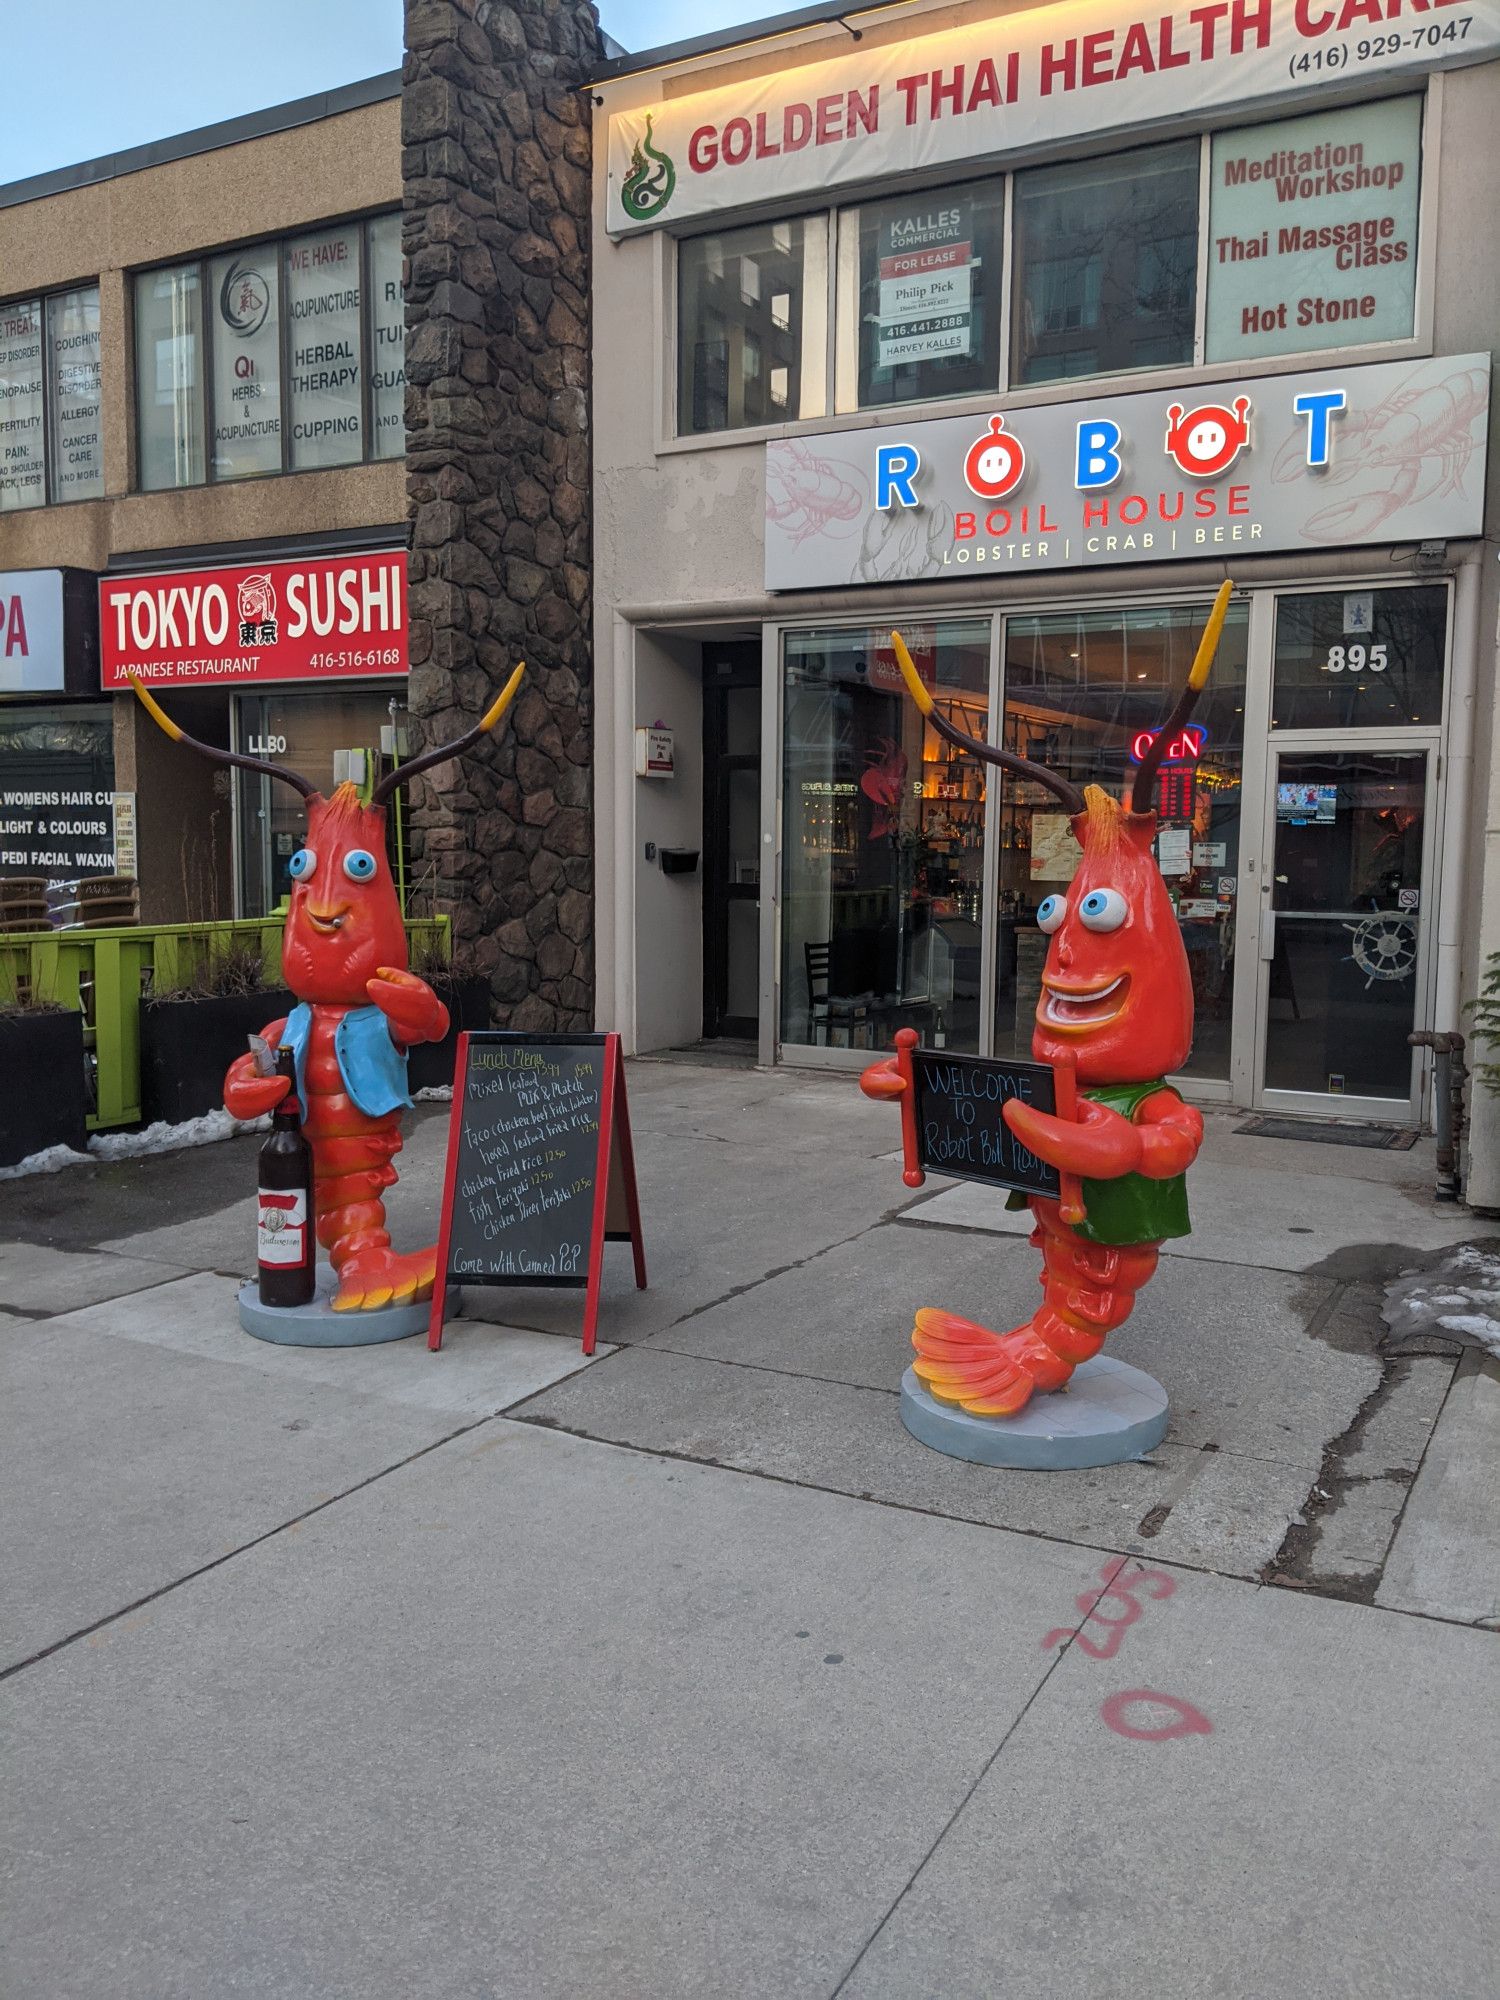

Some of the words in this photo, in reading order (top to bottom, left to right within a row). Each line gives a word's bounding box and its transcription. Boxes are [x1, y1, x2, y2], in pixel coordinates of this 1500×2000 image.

[1289, 43, 1349, 79] (416)
[1357, 17, 1473, 60] 929-7047
[688, 85, 879, 173] GOLDEN
[897, 52, 1020, 126] THAI
[1040, 0, 1272, 96] HEALTH
[1295, 0, 1471, 37] CA
[1225, 142, 1364, 187] Meditation
[1275, 161, 1404, 203] Workshop
[890, 209, 960, 237] KALLES
[890, 228, 960, 249] COMMERCIAL
[1216, 231, 1269, 263] Thai
[1278, 216, 1395, 255] Massage
[290, 250, 309, 271] WE
[312, 242, 348, 266] HAVE:
[894, 258, 918, 272] FOR
[921, 251, 956, 267] LEASE
[1335, 239, 1409, 272] Class
[895, 286, 927, 300] Philip
[930, 280, 954, 294] Pick
[290, 289, 360, 320] ACUPUNCTURE
[1242, 303, 1287, 334] Hot
[1297, 295, 1376, 326] Stone
[887, 316, 963, 337] 416.441.2888
[8, 345, 40, 362] DISORDER
[295, 341, 354, 367] HERBAL
[886, 343, 923, 355] HARVEY
[926, 336, 962, 350] KALLES
[58, 361, 102, 380] DIGESTIVE
[291, 366, 358, 394] THERAPY
[371, 369, 407, 390] GUA
[58, 378, 103, 396] DISORDER
[232, 384, 261, 402] HERBS
[60, 405, 100, 422] ALLERGY
[243, 405, 250, 418] &
[375, 414, 399, 428] AND
[215, 419, 280, 441] ACUPUNCTURE
[293, 416, 358, 440] CUPPING
[62, 434, 98, 449] CANCER
[5, 445, 29, 460] PAIN:
[68, 450, 92, 463] CARE
[11, 460, 43, 474] SHOULDER
[60, 473, 75, 483] AND
[77, 469, 100, 480] MORE
[20, 474, 42, 487] LEGS
[954, 503, 1059, 541] BOIL
[1083, 484, 1252, 530] HOUSE
[943, 541, 1049, 565] LOBSTER
[1086, 532, 1154, 553] CRAB
[1194, 523, 1264, 545] BEER
[110, 584, 229, 652] TOKYO
[285, 565, 402, 638] SUSHI
[113, 661, 174, 680] JAPANESE
[176, 656, 260, 676] RESTAURANT
[309, 648, 400, 668] 416-516-6168
[1327, 644, 1388, 673] 895
[248, 735, 287, 753] LLBO
[1133, 730, 1200, 759] OEN
[3, 791, 59, 806] WOMENS
[61, 791, 93, 806] HAIR
[0, 821, 33, 834] LIGHT
[38, 821, 47, 834] &
[50, 821, 107, 835] COLOURS
[1, 851, 27, 865] PEDI
[31, 851, 72, 866] FACIAL
[471, 1044, 509, 1067] Lunch
[513, 1047, 544, 1067] Menu
[540, 1086, 551, 1101] &
[924, 1064, 1033, 1104] WELCOME
[948, 1097, 976, 1125] TO
[924, 1122, 976, 1163] Robot
[453, 1248, 483, 1273] Come
